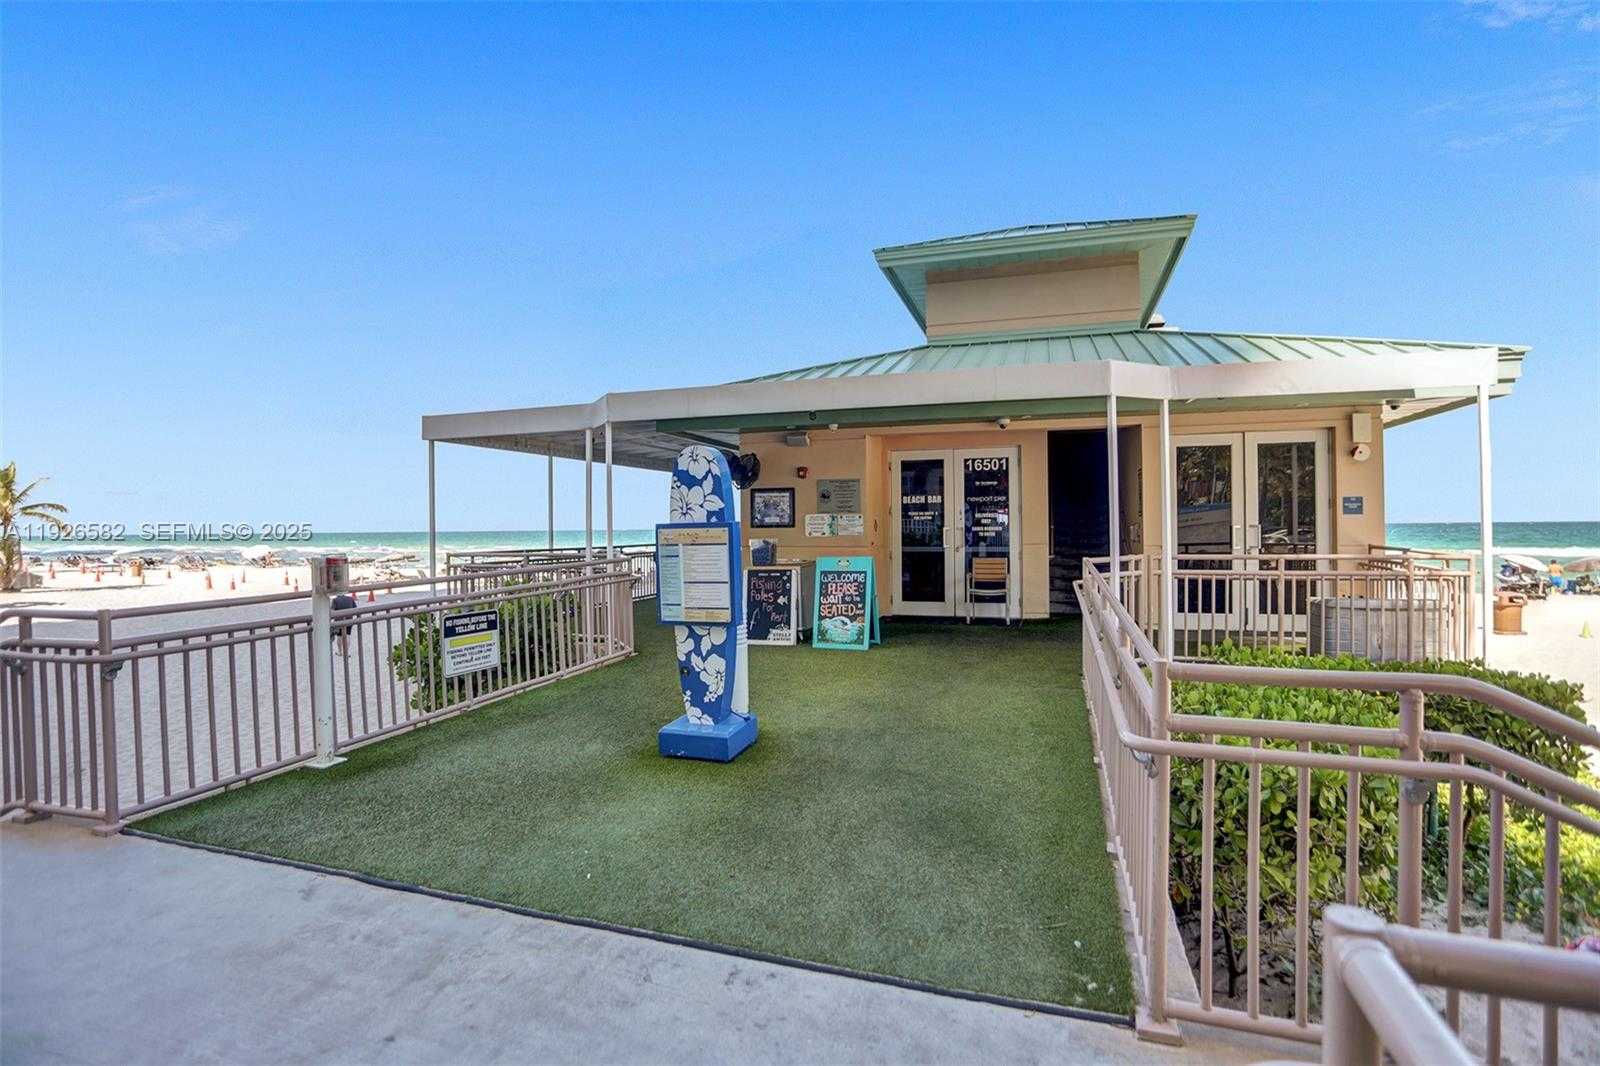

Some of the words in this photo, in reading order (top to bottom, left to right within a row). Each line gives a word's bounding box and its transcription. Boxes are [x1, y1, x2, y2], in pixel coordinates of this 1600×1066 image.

[966, 459, 1007, 471] 16501
[902, 496, 925, 504] BEACH
[827, 582, 859, 595] PLEASE
[820, 603, 856, 617] SEATED
[454, 617, 470, 626] FISHING
[471, 615, 487, 623] BEFORE
[456, 625, 475, 633] YELLOW
